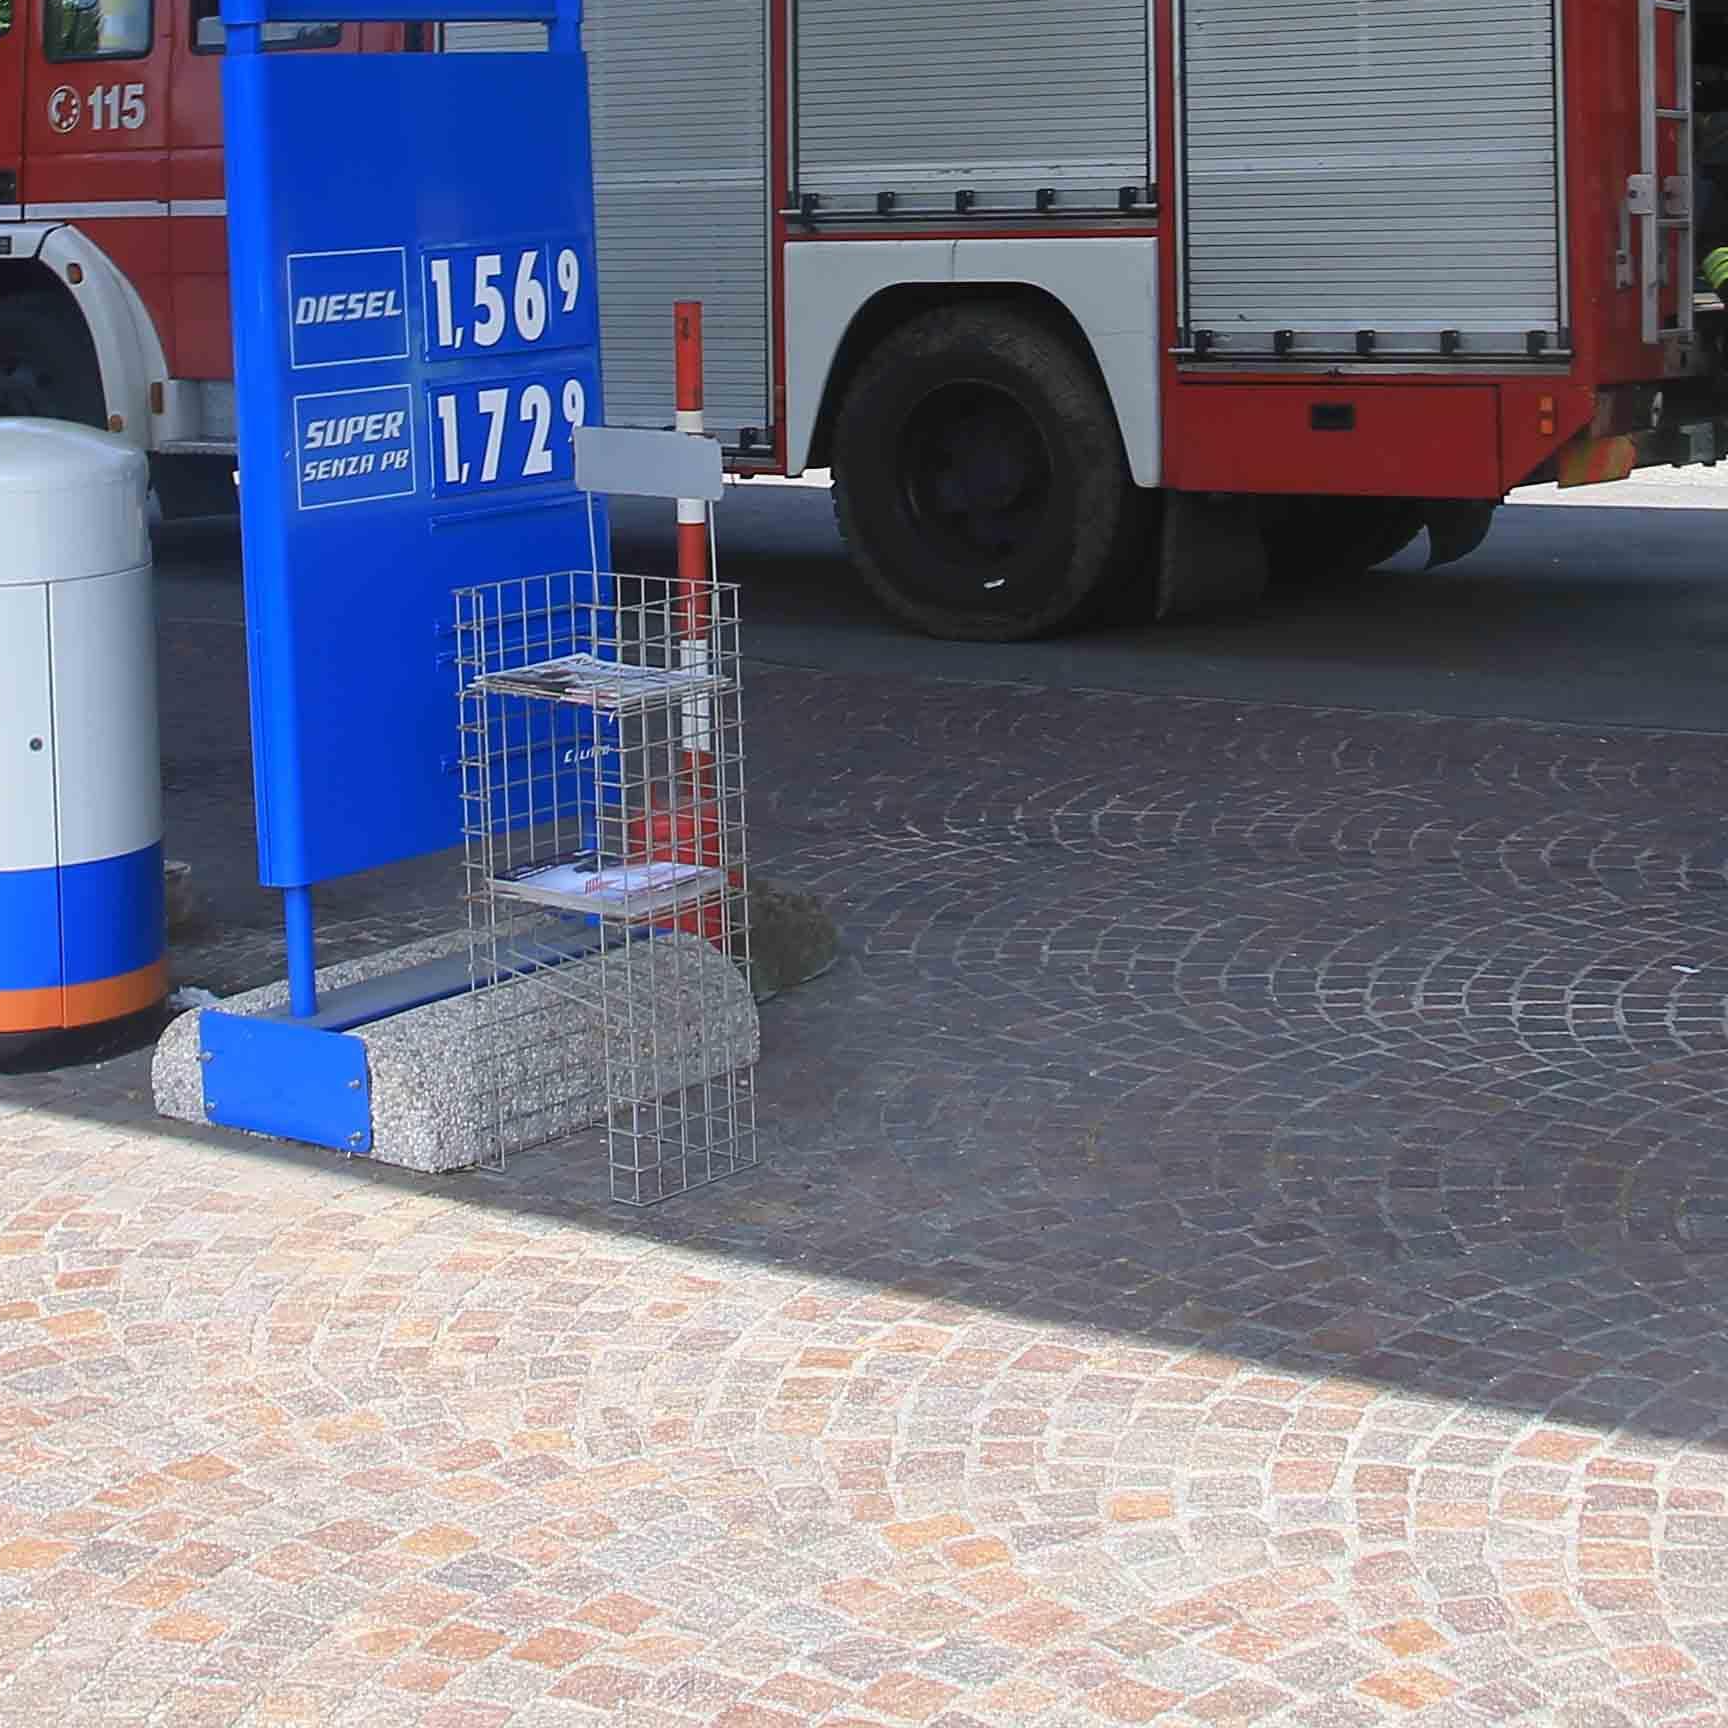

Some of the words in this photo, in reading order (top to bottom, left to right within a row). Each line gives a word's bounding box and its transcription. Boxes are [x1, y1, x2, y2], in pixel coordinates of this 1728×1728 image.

[87, 82, 146, 130] 115
[295, 289, 403, 325] DIESEL
[303, 409, 406, 450] SUPER
[302, 452, 375, 483] SENZA
[380, 447, 411, 472] PB
